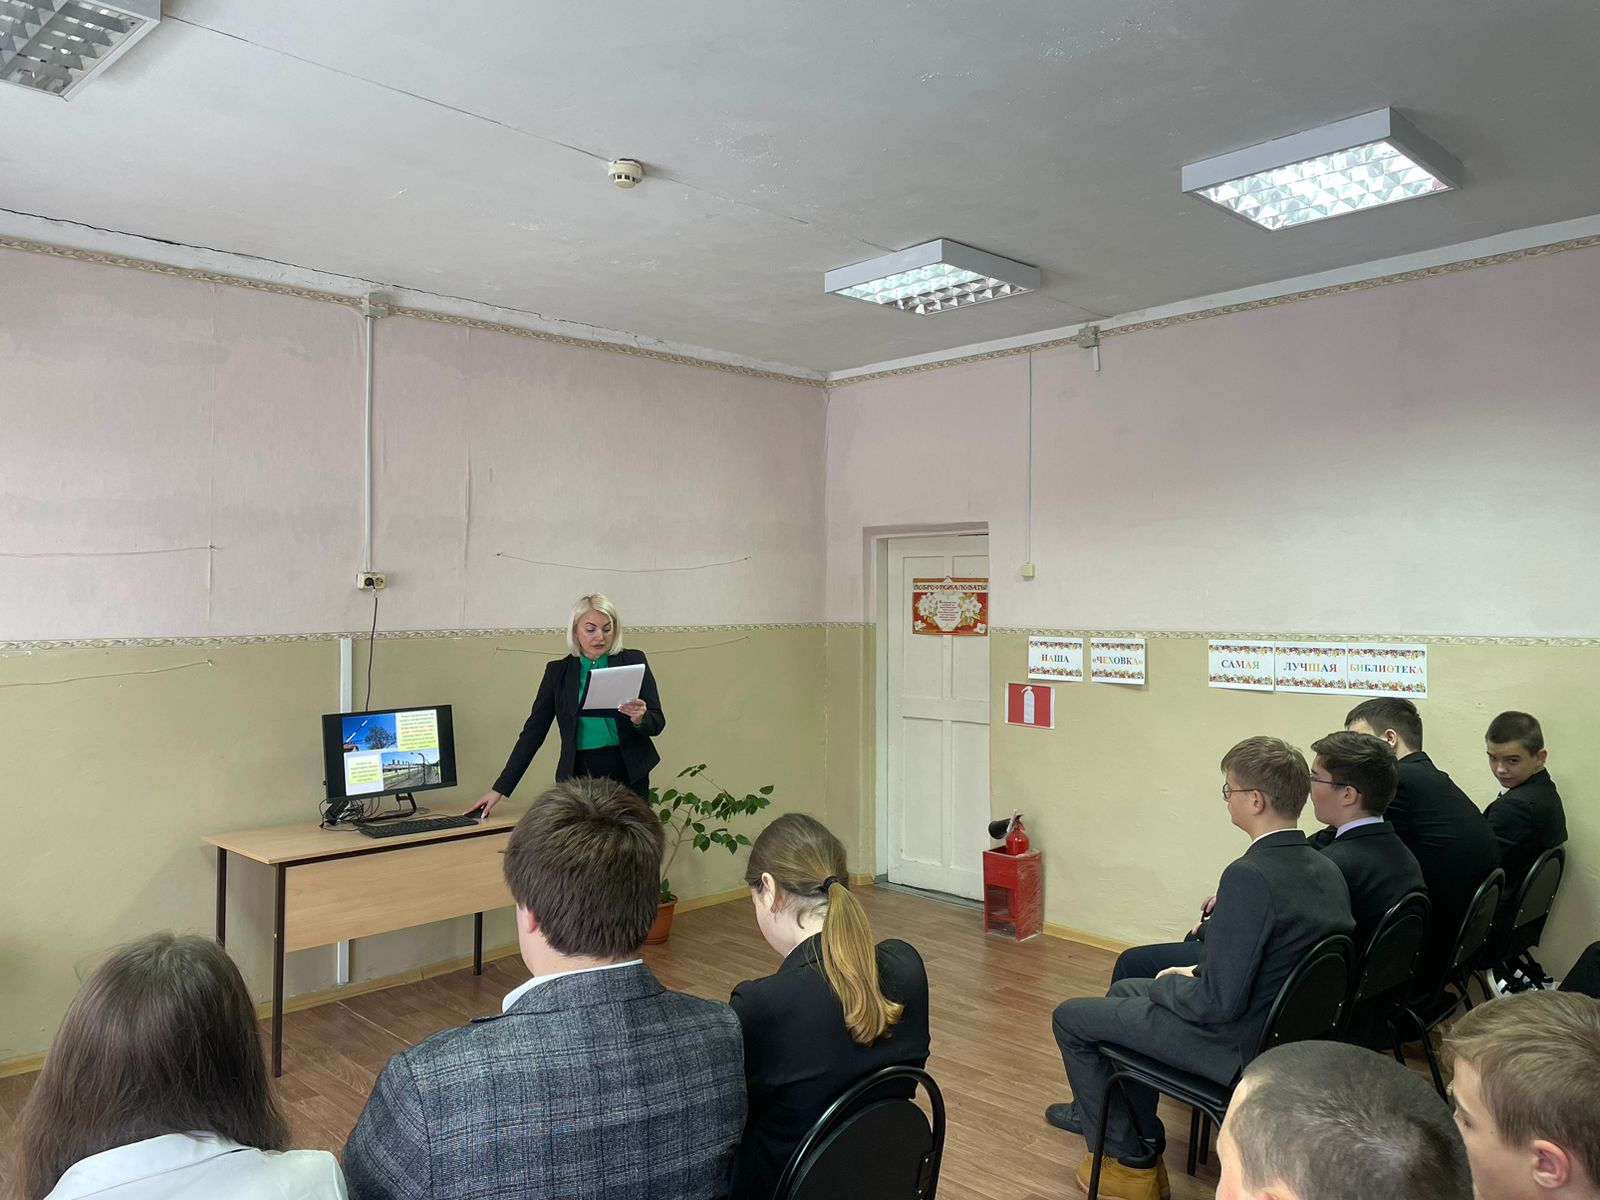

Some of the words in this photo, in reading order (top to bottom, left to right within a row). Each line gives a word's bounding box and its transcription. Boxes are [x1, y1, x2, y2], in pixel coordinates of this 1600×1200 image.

[1041, 654, 1069, 663] НАША
[1093, 656, 1143, 665] «ЧЕХОВКА»
[1221, 659, 1260, 669] САМАЯ
[1283, 662, 1337, 673] ЛУЧШАЯ
[1349, 663, 1424, 674] БИБЛИОТЕКА
